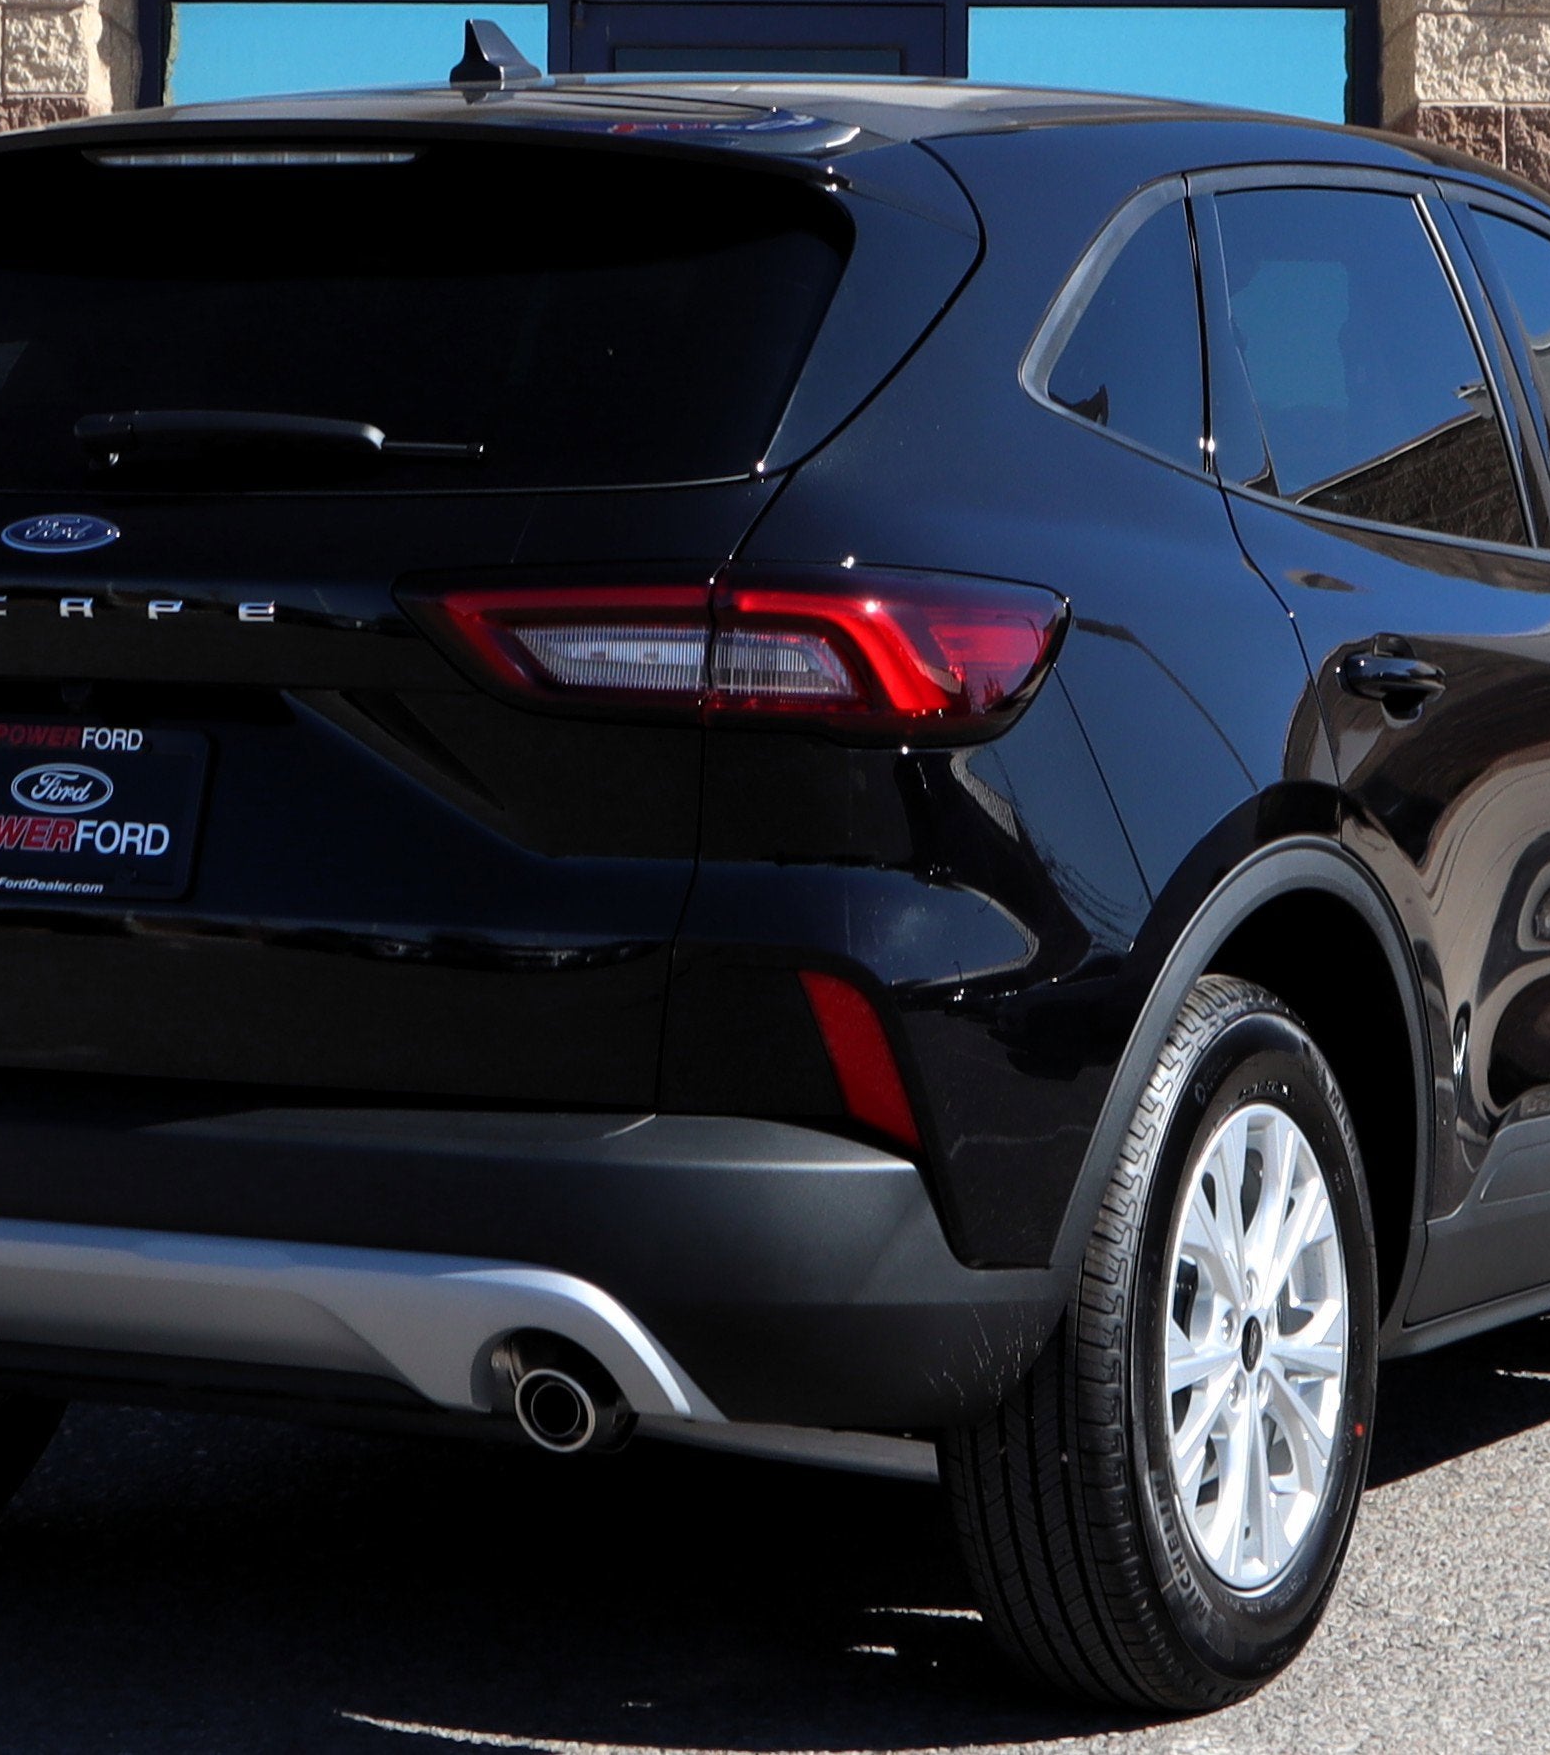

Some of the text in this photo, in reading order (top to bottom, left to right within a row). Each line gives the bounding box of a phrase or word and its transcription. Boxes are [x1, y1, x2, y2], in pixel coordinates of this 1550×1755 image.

[24, 515, 94, 541] Ford
[30, 770, 94, 803] Ford
[1153, 1477, 1211, 1619] MICHELIN
